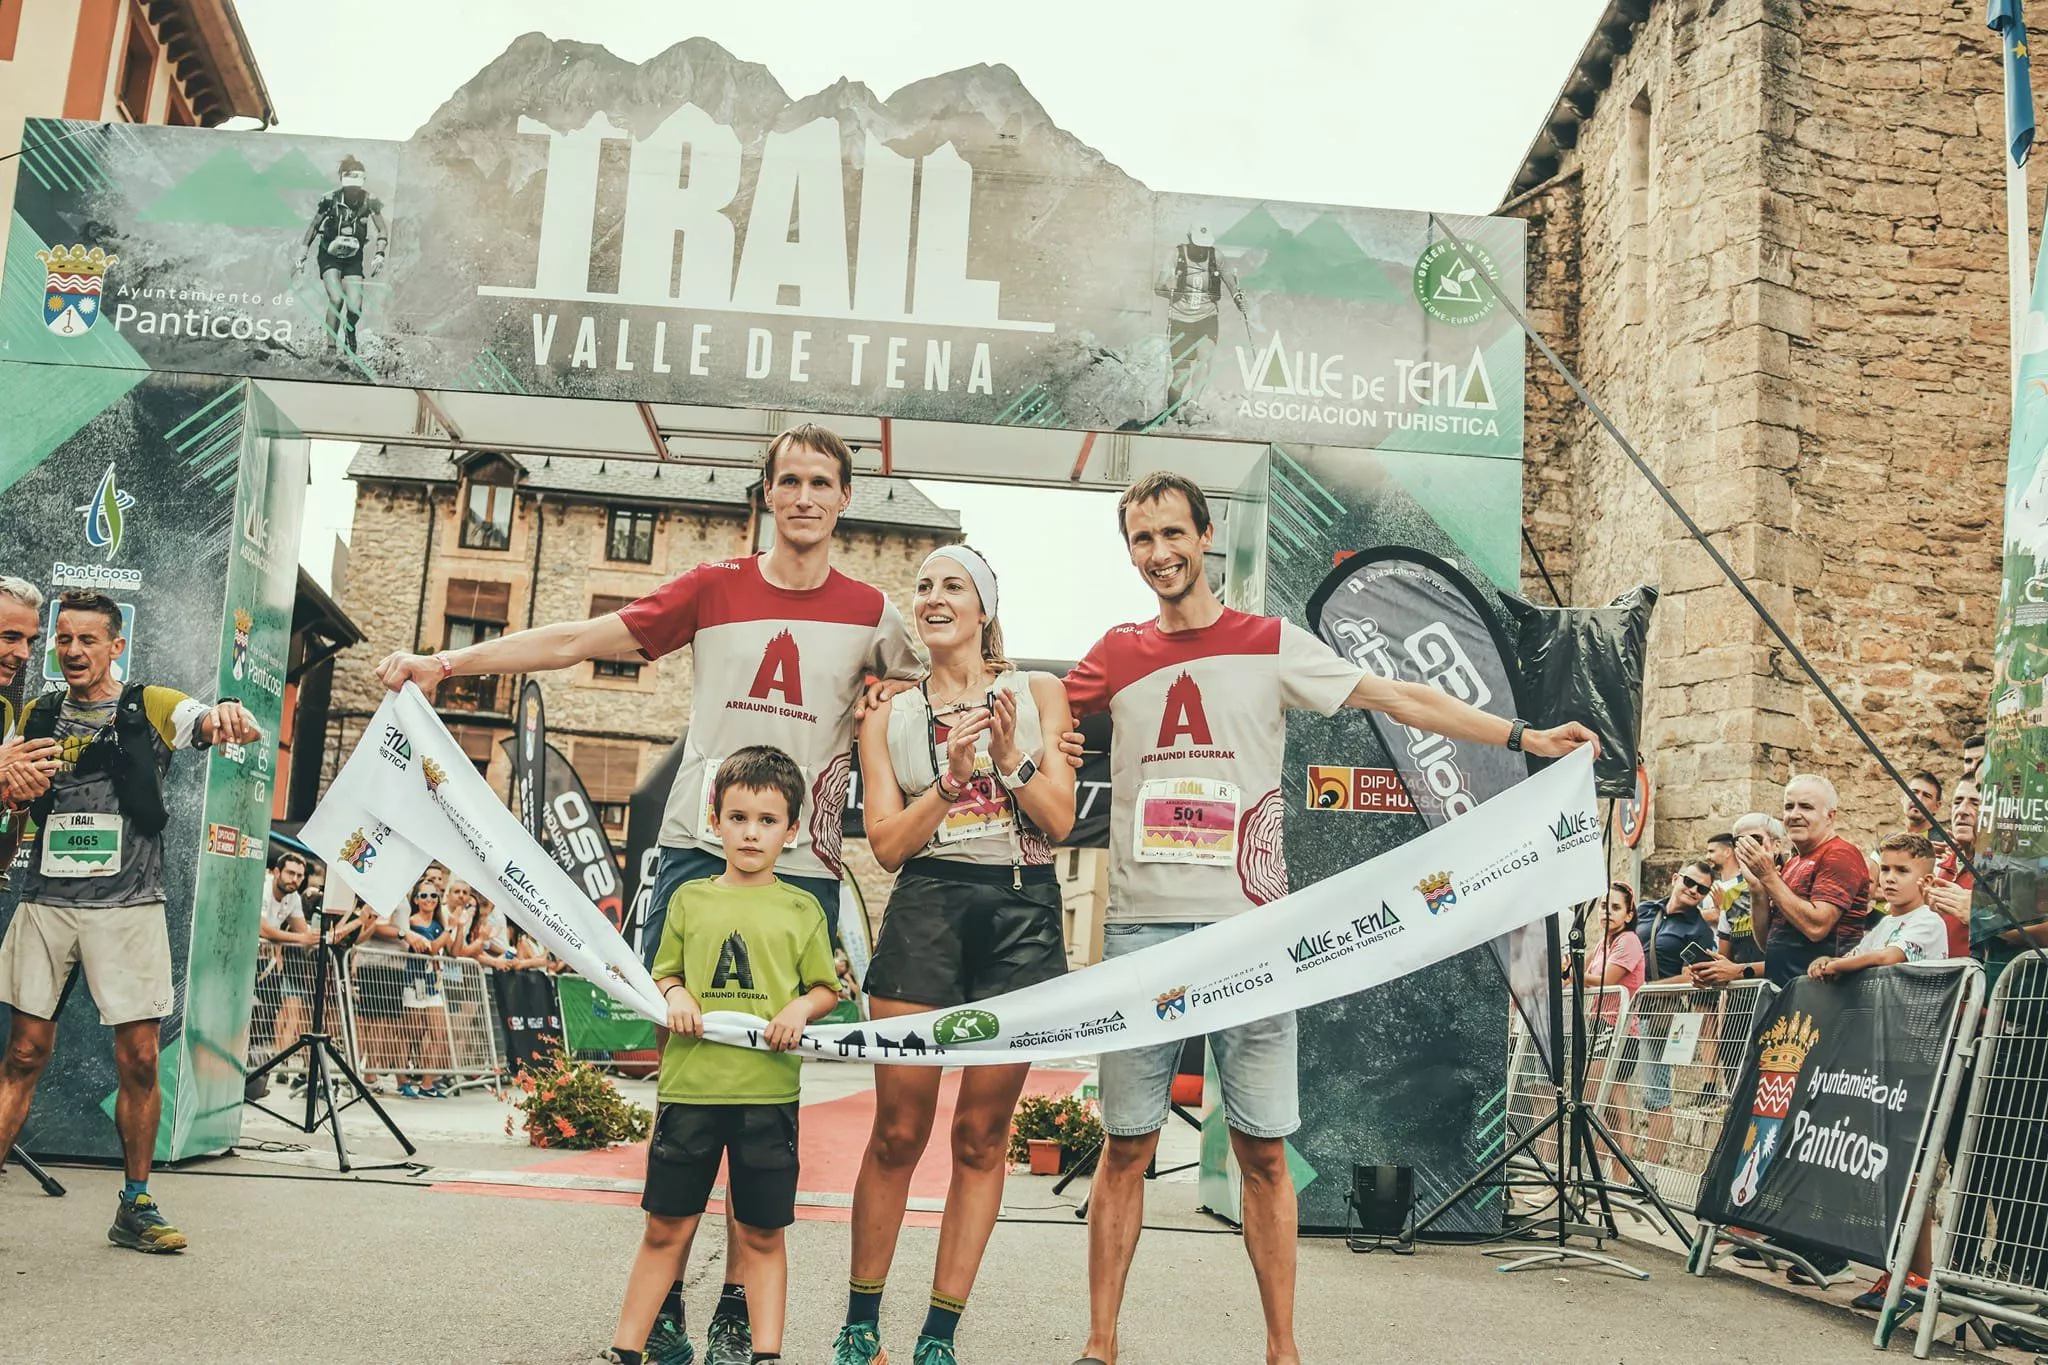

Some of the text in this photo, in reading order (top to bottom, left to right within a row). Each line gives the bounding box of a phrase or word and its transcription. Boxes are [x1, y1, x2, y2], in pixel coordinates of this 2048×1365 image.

[517, 101, 1001, 322] TRAIL
[1417, 244, 1446, 278] GREEN
[116, 283, 295, 306] Ayuntamiento de
[114, 303, 293, 342] Panticosa
[532, 313, 994, 396] VALLE DE TENA
[1235, 328, 1498, 411] VALLE DE TENA
[1237, 399, 1500, 438] ASOCIACION TURISTICA
[54, 563, 141, 581] Panticosa
[247, 657, 282, 698] Panticosa
[725, 700, 819, 725] ARRIAUNDI EGURRAK
[1141, 749, 1236, 766] ARRIAUNDI EGURRAK
[1218, 786, 1228, 797] R
[1361, 792, 1382, 807] DE
[70, 815, 95, 826] TRAIL
[1172, 806, 1204, 822] 501
[1548, 810, 1588, 842] VALLE
[67, 835, 99, 846] 4065
[1461, 849, 1539, 897] Panticosa
[498, 874, 583, 951] ASOCIACION TURISTICA
[1287, 899, 1401, 964] VALLE DE TENA
[1295, 924, 1405, 975] ASOCIACION TURISTICA
[1190, 970, 1274, 1008] Panticosa
[1009, 1032, 1072, 1050] ASOCIACION
[1075, 1021, 1127, 1040] TURISTICA
[1887, 1078, 1909, 1113] de
